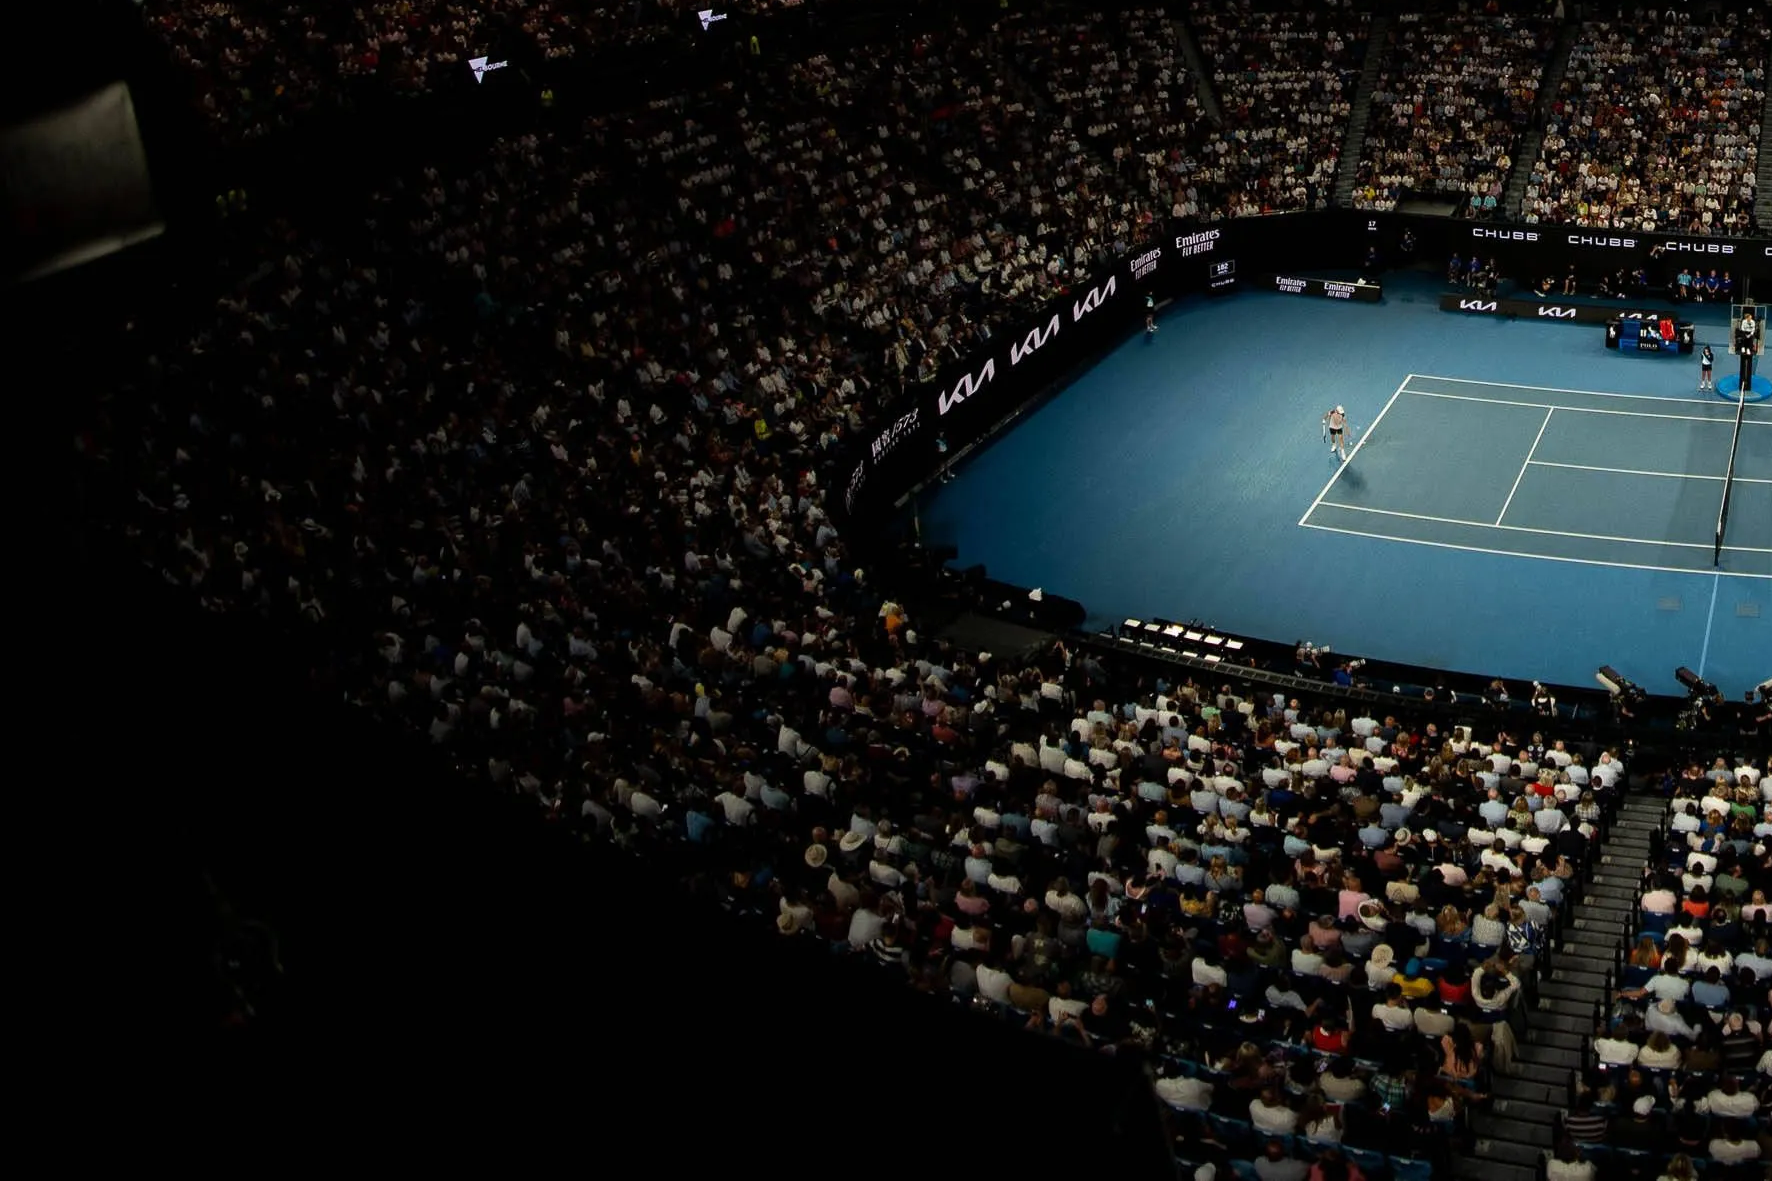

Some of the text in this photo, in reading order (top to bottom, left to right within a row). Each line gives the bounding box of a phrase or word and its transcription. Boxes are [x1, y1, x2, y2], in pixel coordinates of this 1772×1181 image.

[1176, 229, 1220, 249] Emirates
[1193, 240, 1214, 254] BETTER
[1472, 228, 1539, 241] CHUBB
[1568, 235, 1636, 248] CHUBB
[1665, 241, 1735, 254] CHUBB
[1130, 247, 1161, 272] Emirates
[1276, 276, 1307, 288] Emirates
[1324, 281, 1355, 293] Emirates
[1074, 275, 1115, 322] KIA
[1460, 299, 1577, 318] KIA KIA
[1011, 314, 1060, 365] KIA
[939, 358, 995, 415] KIA
